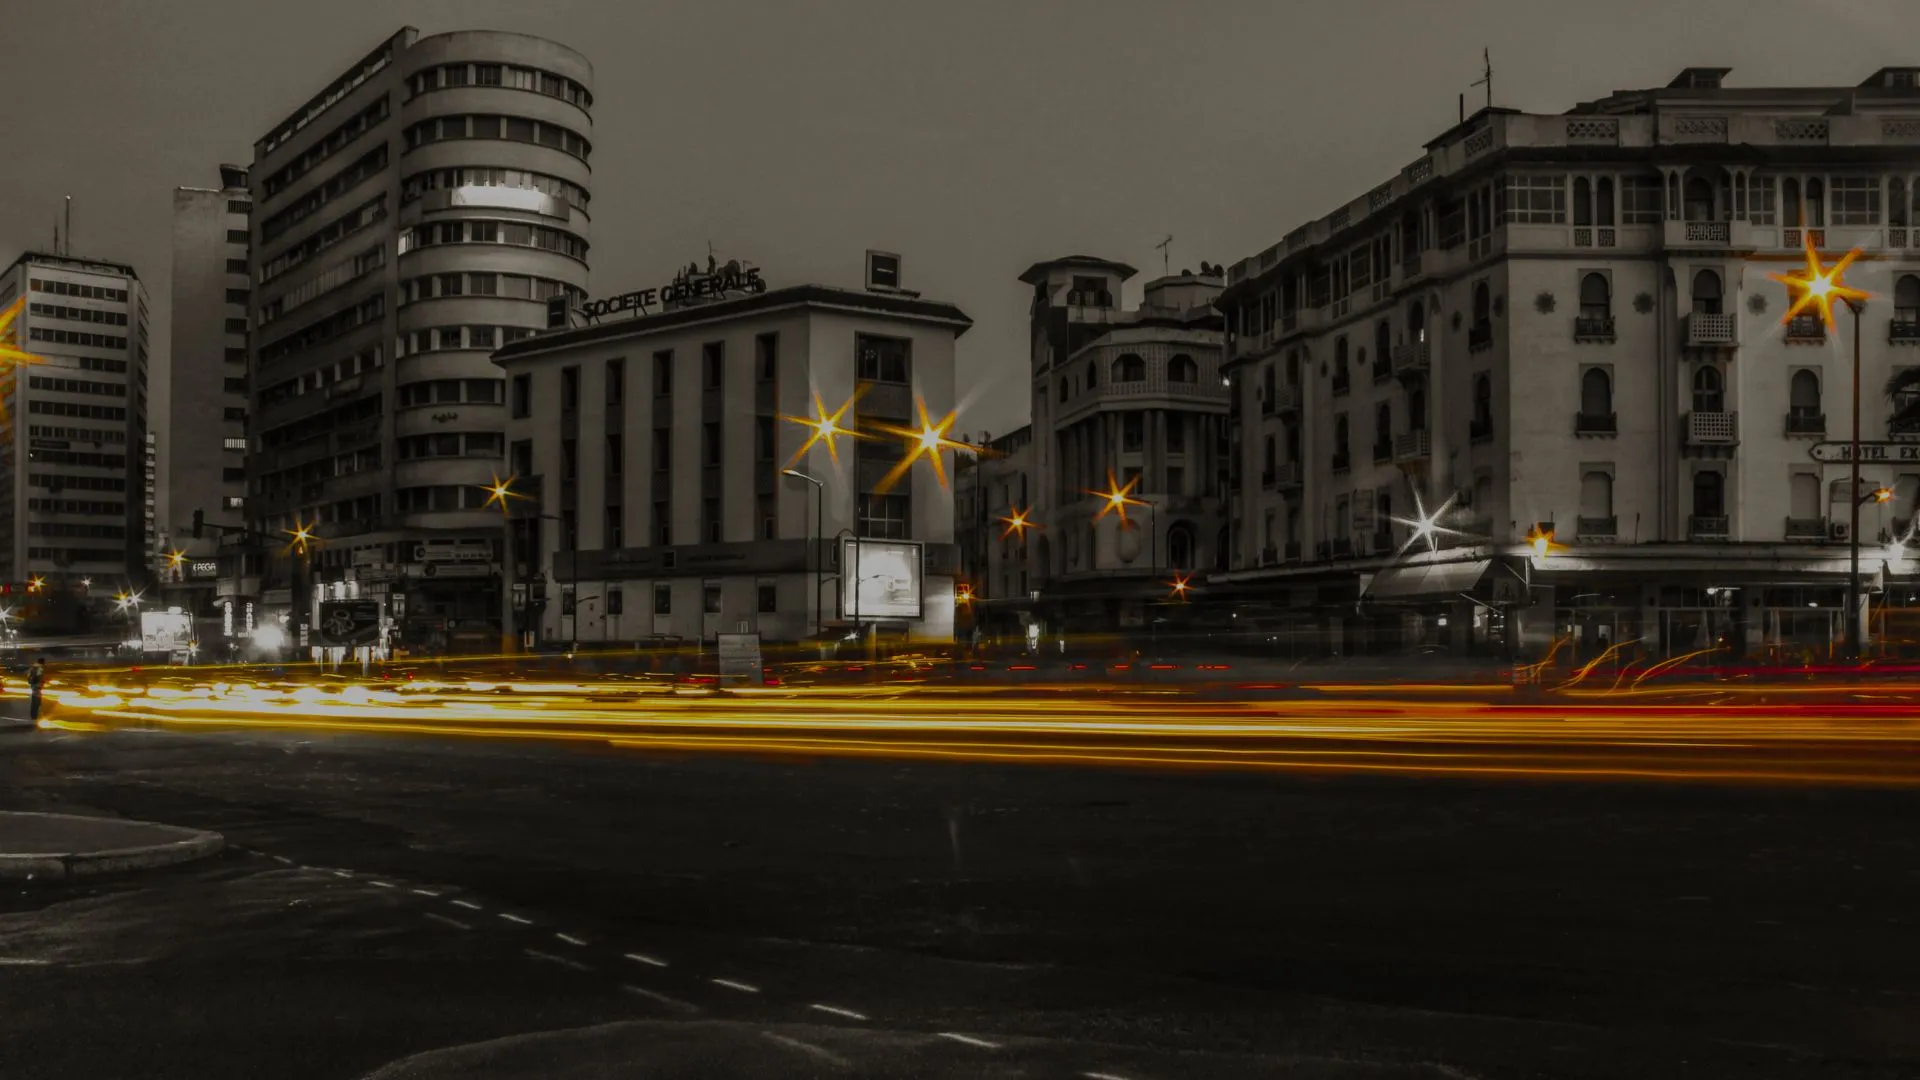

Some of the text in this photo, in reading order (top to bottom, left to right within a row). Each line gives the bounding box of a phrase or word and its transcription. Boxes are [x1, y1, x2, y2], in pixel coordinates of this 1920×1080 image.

[583, 267, 760, 318] SOCIETE GENERALE
[1842, 446, 1888, 459] HTEL
